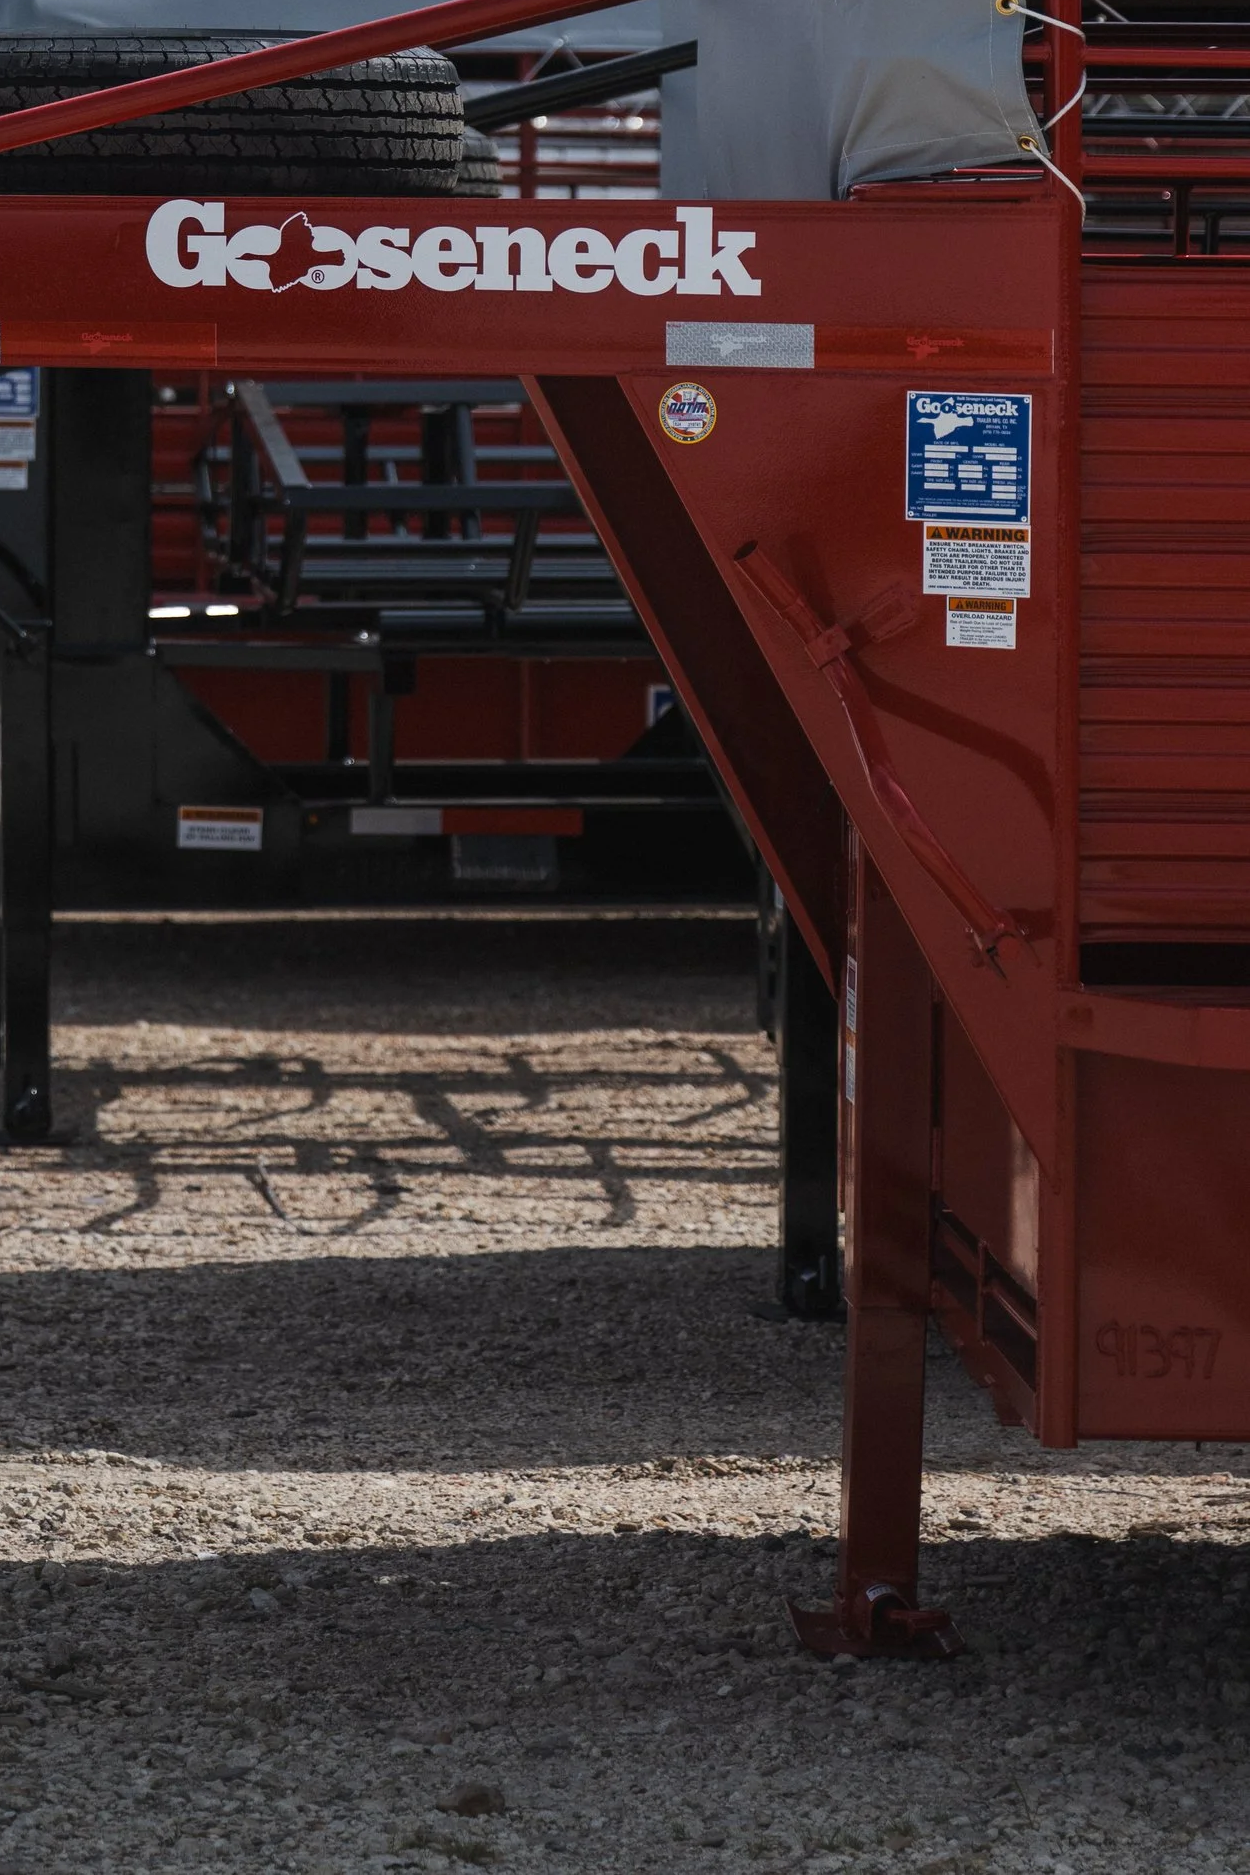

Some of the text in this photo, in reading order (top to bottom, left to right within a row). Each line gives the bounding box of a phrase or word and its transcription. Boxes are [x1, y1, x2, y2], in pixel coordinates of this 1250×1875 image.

[146, 198, 761, 296] Gooseneck
[916, 397, 1019, 416] Gooseneck
[946, 526, 1025, 541] WARNING
[965, 600, 1007, 611] WARNING
